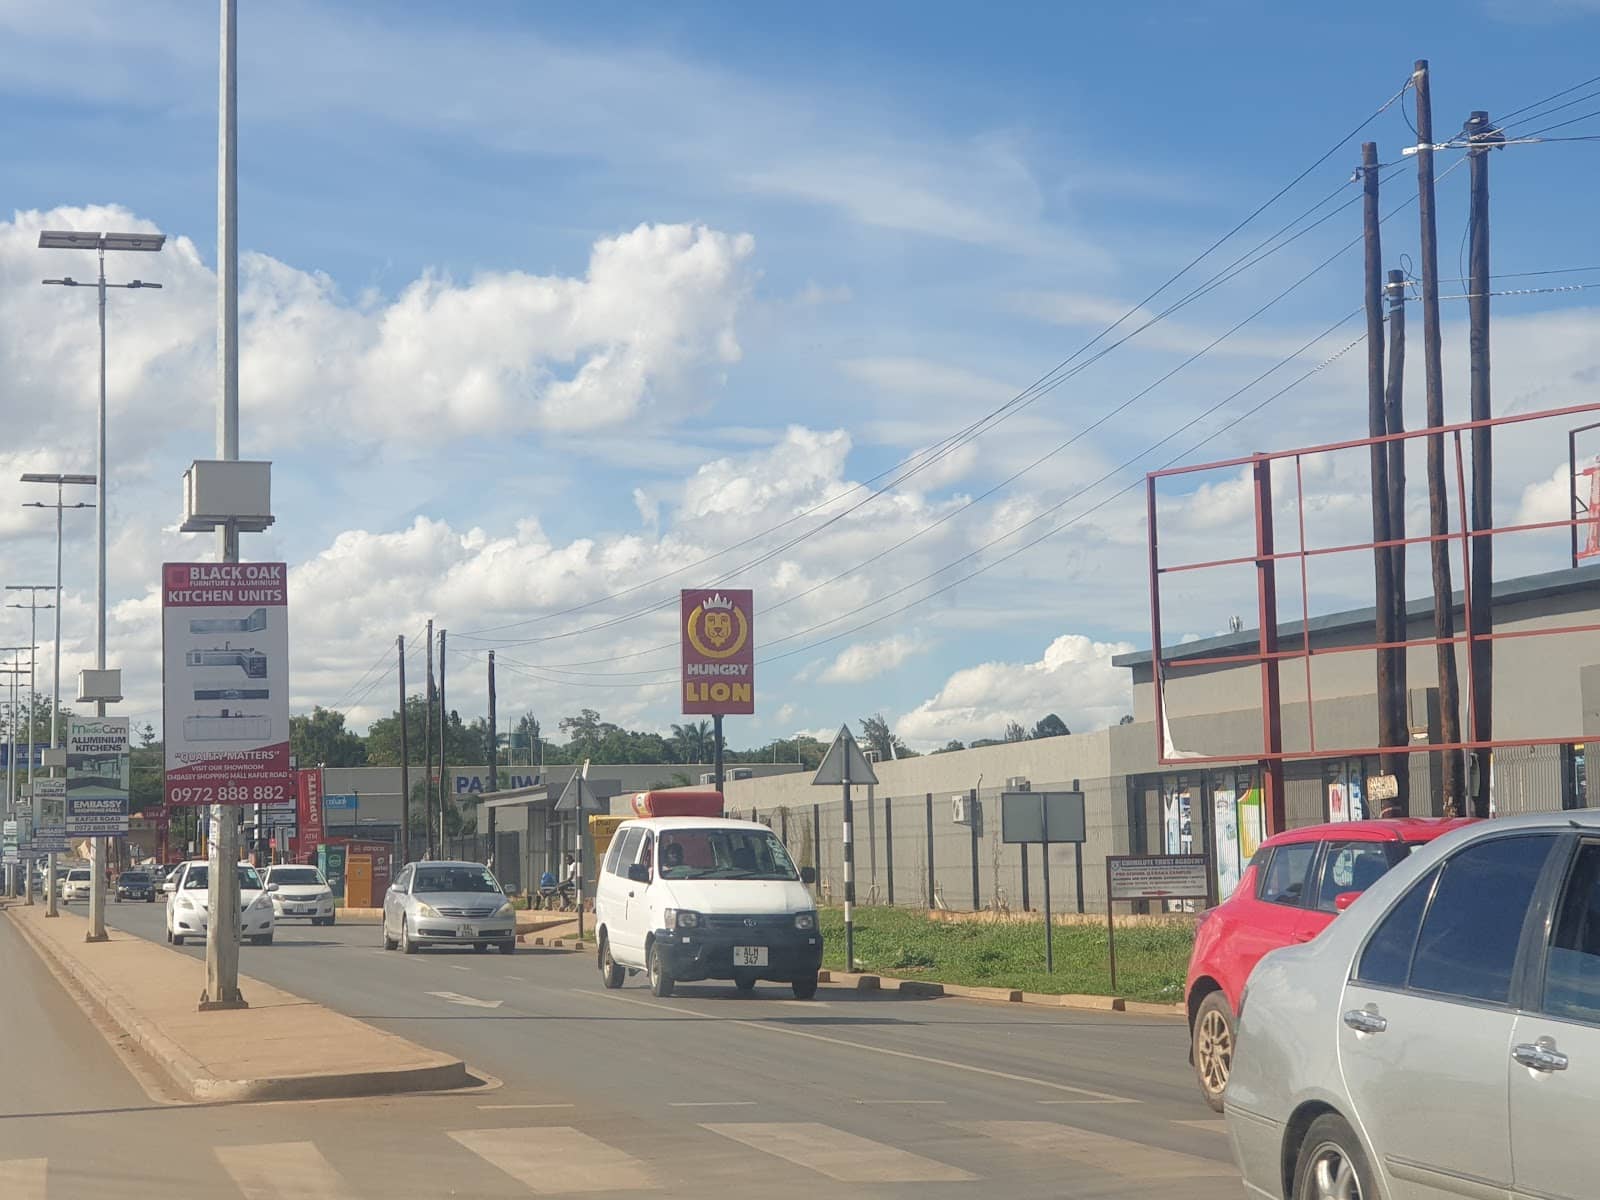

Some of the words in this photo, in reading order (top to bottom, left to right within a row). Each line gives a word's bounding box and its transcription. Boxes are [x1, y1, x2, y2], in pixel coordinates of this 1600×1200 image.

[190, 566, 242, 580] BLACK
[246, 566, 281, 579] OAK
[168, 590, 233, 602] KITCHEN
[238, 589, 282, 601] UNITS
[687, 663, 748, 676] HUNGRY
[686, 682, 751, 703] LION
[71, 736, 127, 744] ALUMINIUM
[75, 744, 122, 752] KITCHENS
[170, 786, 213, 802] 0972
[217, 786, 249, 801] 888
[253, 785, 284, 800] 882
[73, 800, 122, 809] EMBASSY
